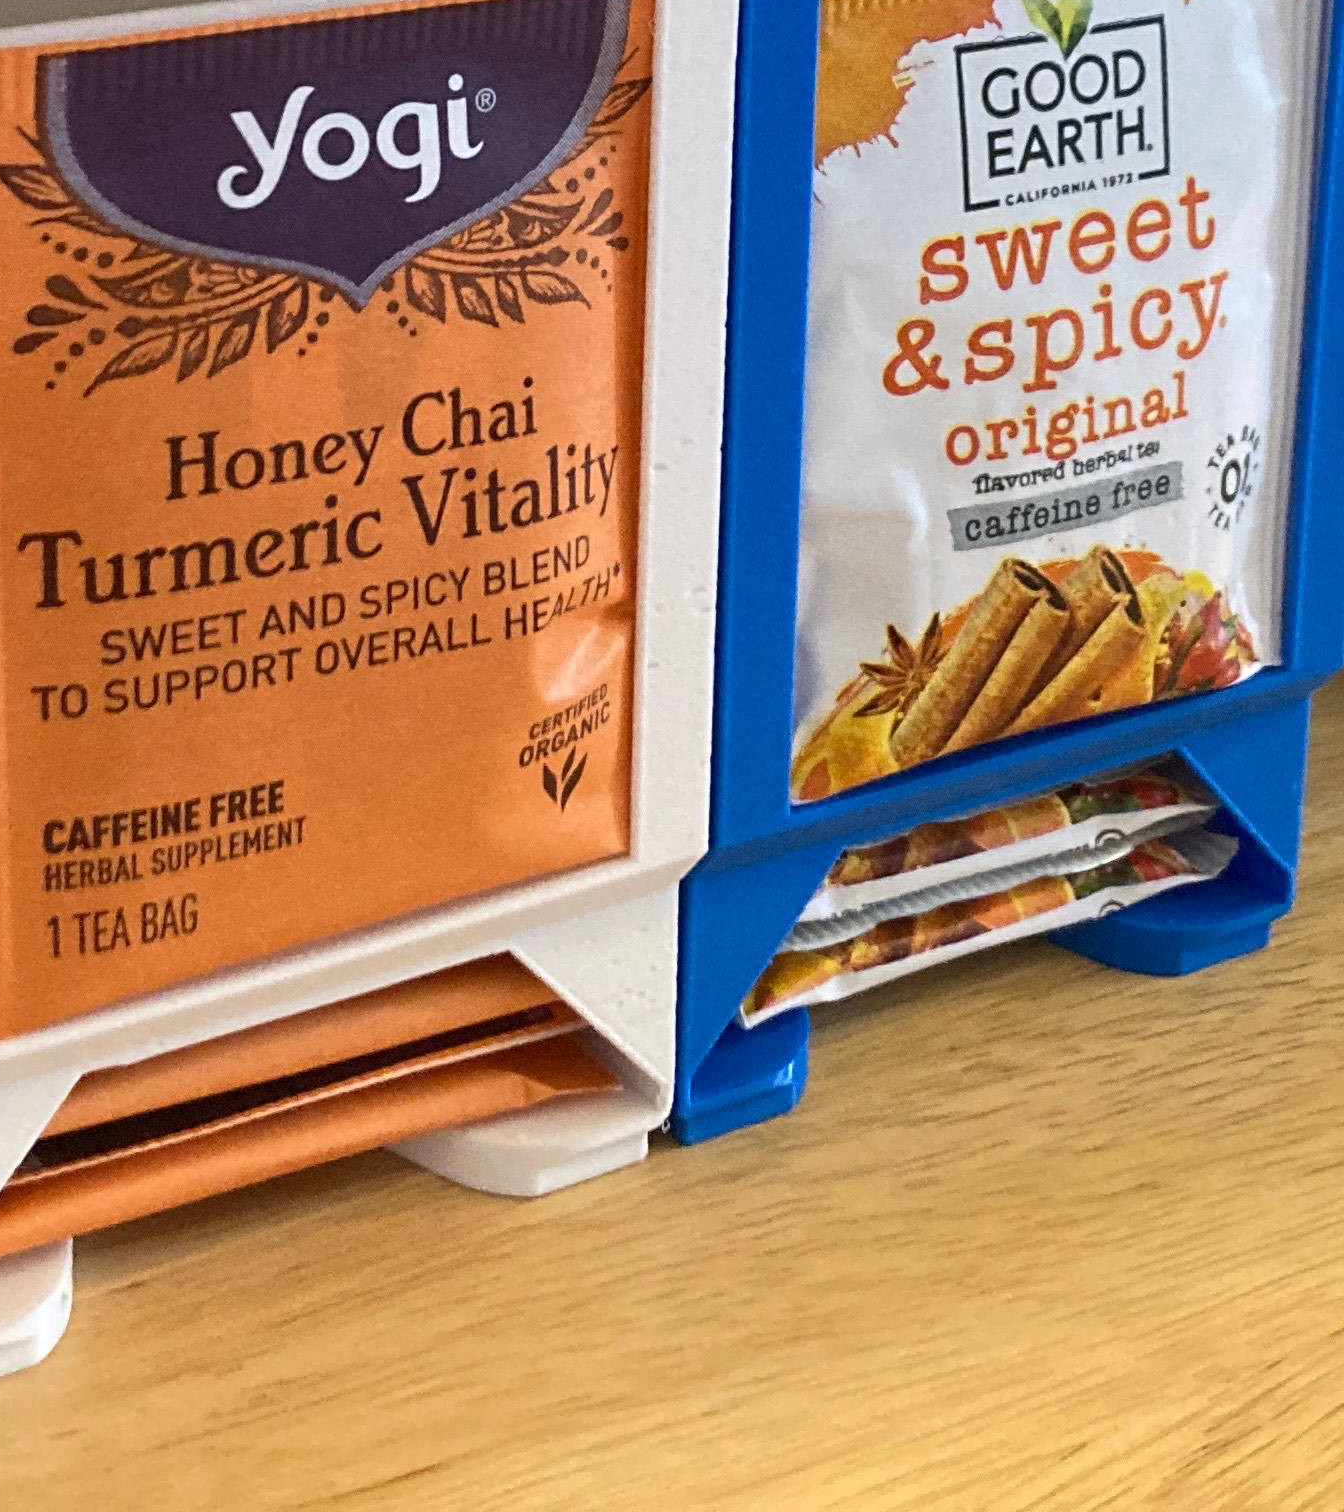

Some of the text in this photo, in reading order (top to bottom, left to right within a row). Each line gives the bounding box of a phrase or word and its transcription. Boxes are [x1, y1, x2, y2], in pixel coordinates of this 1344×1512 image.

[982, 49, 1146, 119] GOOD
[1006, 180, 1097, 206] CALIFORNIA
[919, 176, 1216, 305] sweet
[165, 377, 538, 501] Honey Chai
[945, 371, 1189, 465] original
[973, 461, 1066, 495] flavored
[1072, 444, 1133, 476] herbal
[18, 444, 619, 608] Turmeric Vitality
[965, 474, 1171, 542] caffeine free
[100, 535, 591, 666] SWEET AND SPICY BLEND
[31, 684, 88, 721] TO
[104, 647, 301, 715] SUPPORT
[315, 620, 492, 675] OVERALL
[519, 701, 610, 768] ORGANIC
[529, 683, 608, 740] CERTIFIED
[42, 779, 286, 856] CAFFEINE FREE
[42, 816, 308, 892] HERBAL SUPPLEMENT
[47, 892, 200, 959] 1 TEA BAG
